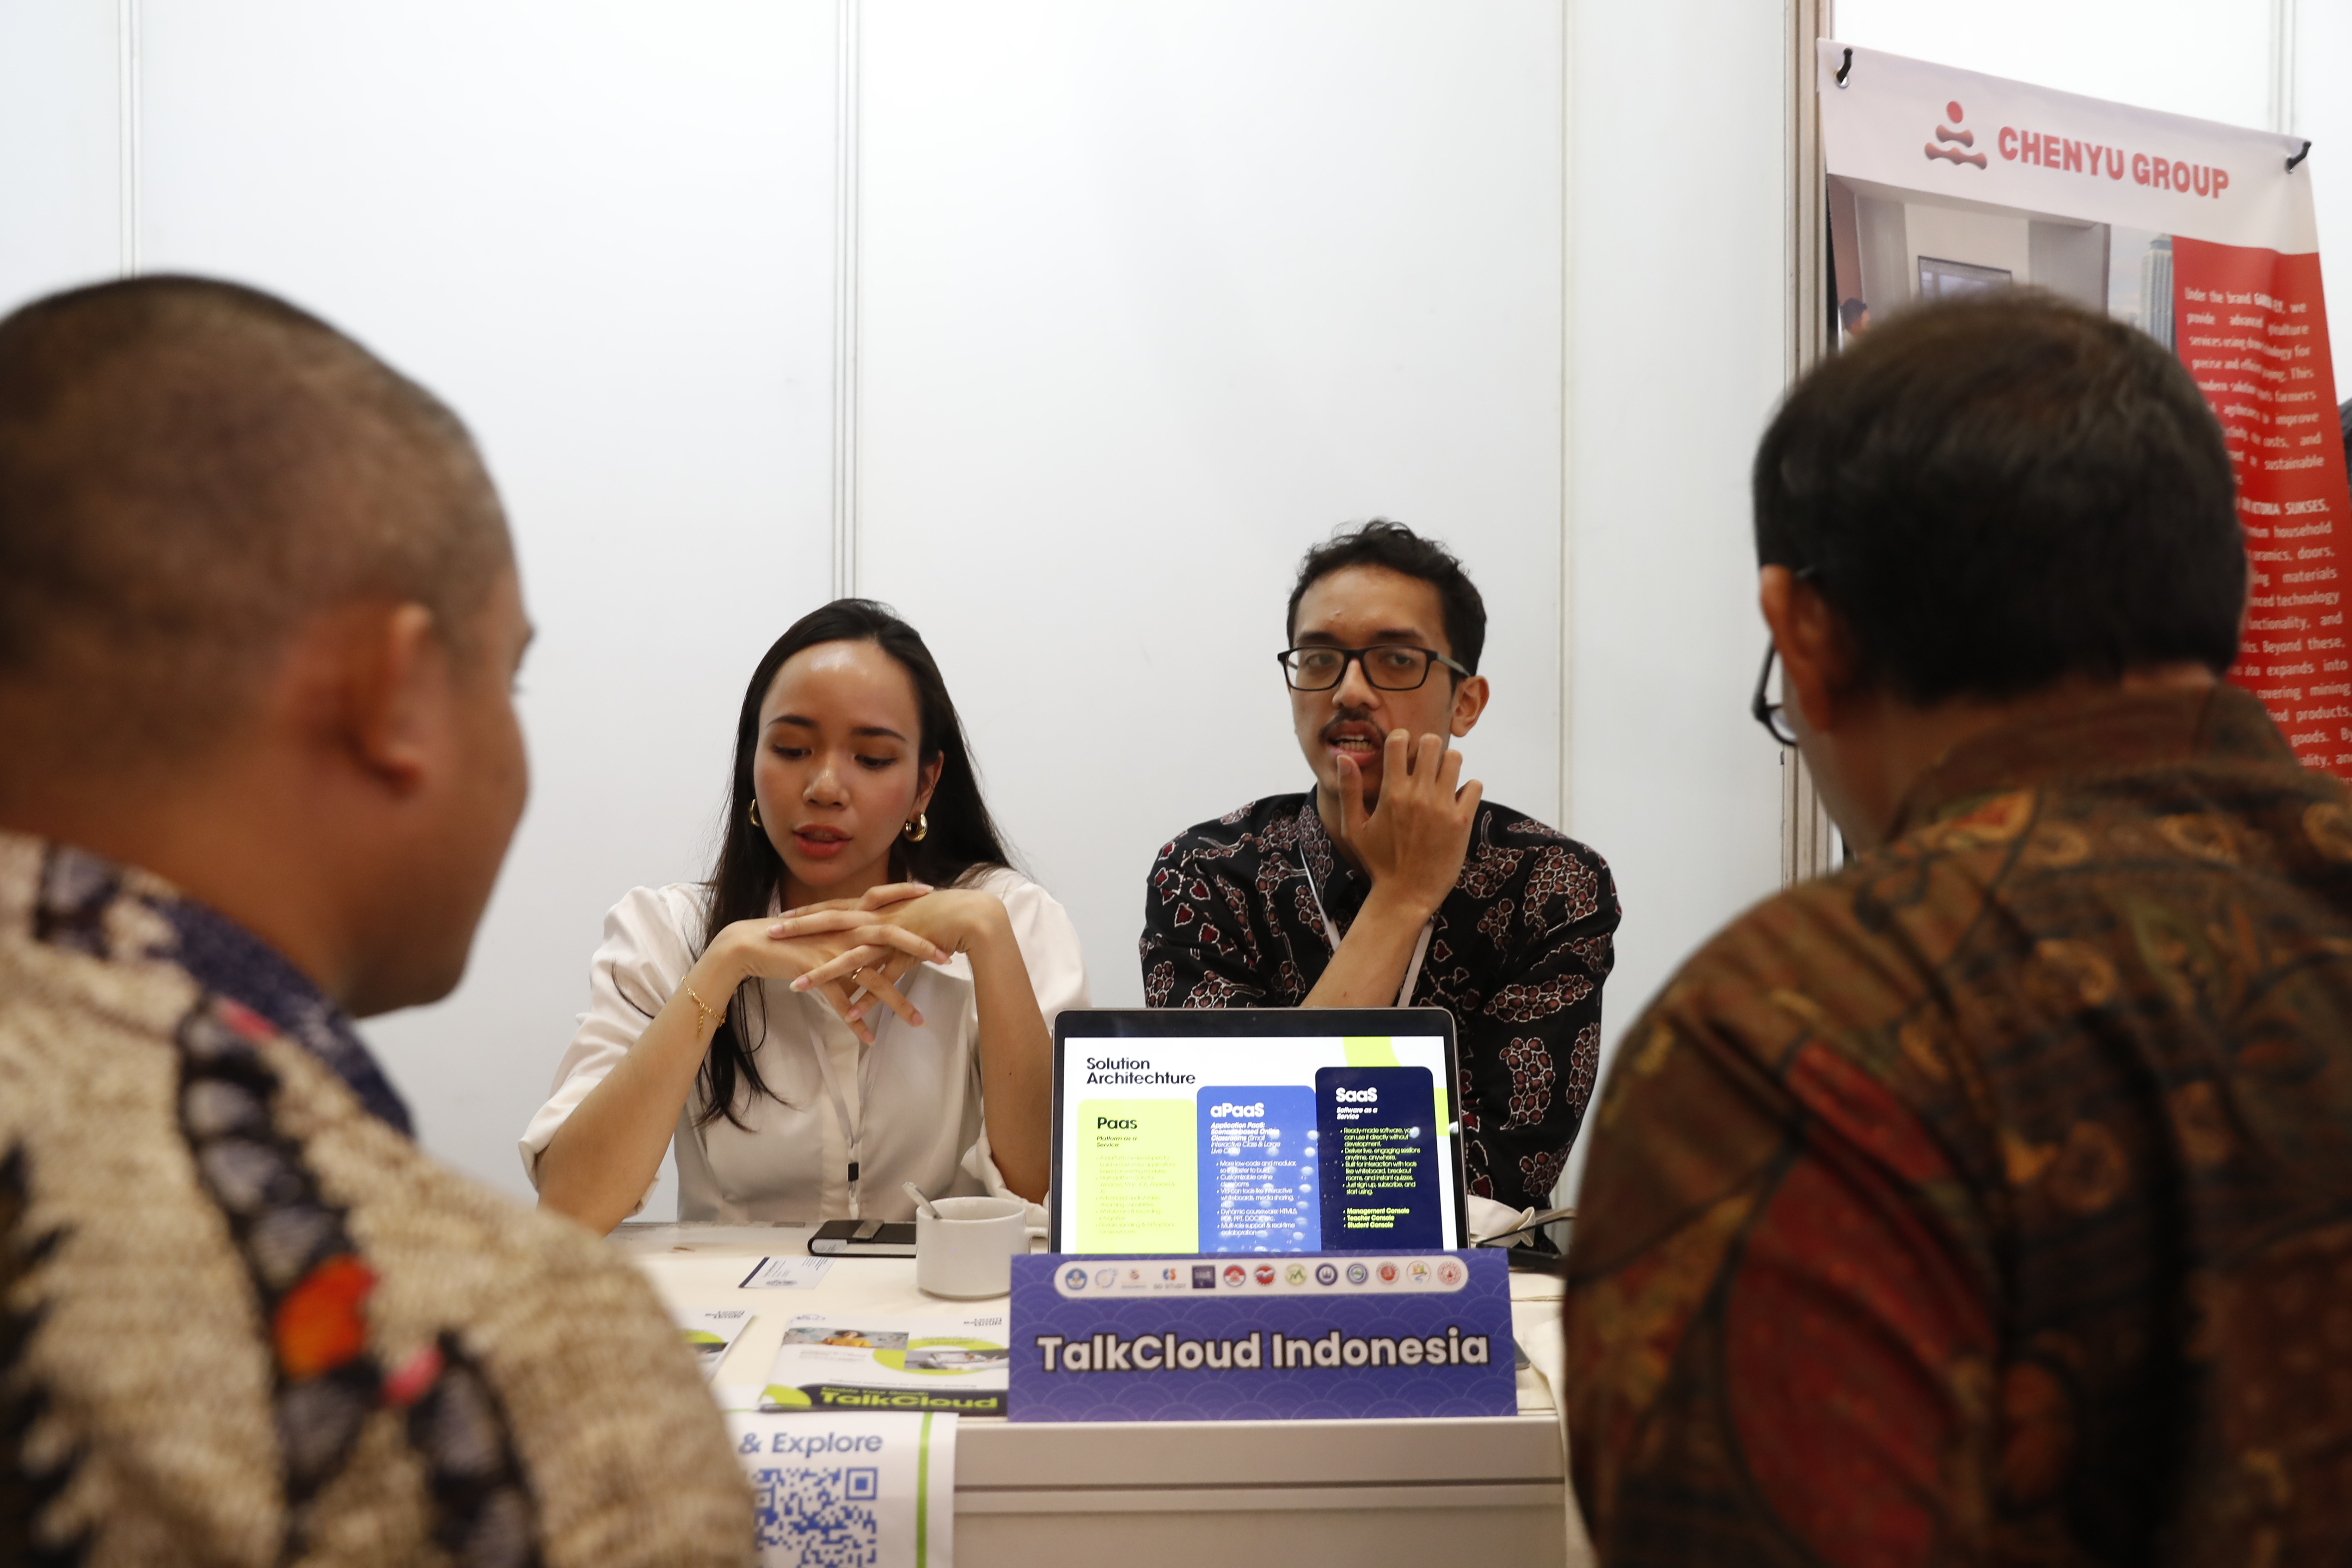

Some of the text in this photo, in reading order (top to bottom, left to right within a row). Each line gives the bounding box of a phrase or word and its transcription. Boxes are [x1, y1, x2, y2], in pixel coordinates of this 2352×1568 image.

[1997, 126, 2229, 199] CHENYU GROUP
[2294, 344, 2311, 357] for
[2291, 368, 2314, 380] This
[2275, 413, 2319, 427] improve
[2300, 431, 2321, 446] and
[2264, 454, 2324, 470] sustainable
[2273, 520, 2331, 538] household
[2282, 567, 2337, 583] materials
[2276, 591, 2340, 606] technology
[2320, 611, 2342, 626] and
[2263, 638, 2302, 656] Beyond
[2266, 661, 2315, 678] expands
[2323, 658, 2348, 671] into
[2257, 681, 2351, 701] covering mining
[2335, 753, 2352, 764] an
[1087, 1057, 1150, 1069] Solution
[1087, 1072, 1196, 1084] Architechture
[1336, 1087, 1378, 1102] SaaS
[1210, 1102, 1265, 1117] aPaaS
[1097, 1117, 1137, 1129] Paas
[1036, 1326, 1491, 1373] TalkCloud Indonesia
[820, 1391, 998, 1409] TalkCloud
[738, 1432, 883, 1459] & Explore
